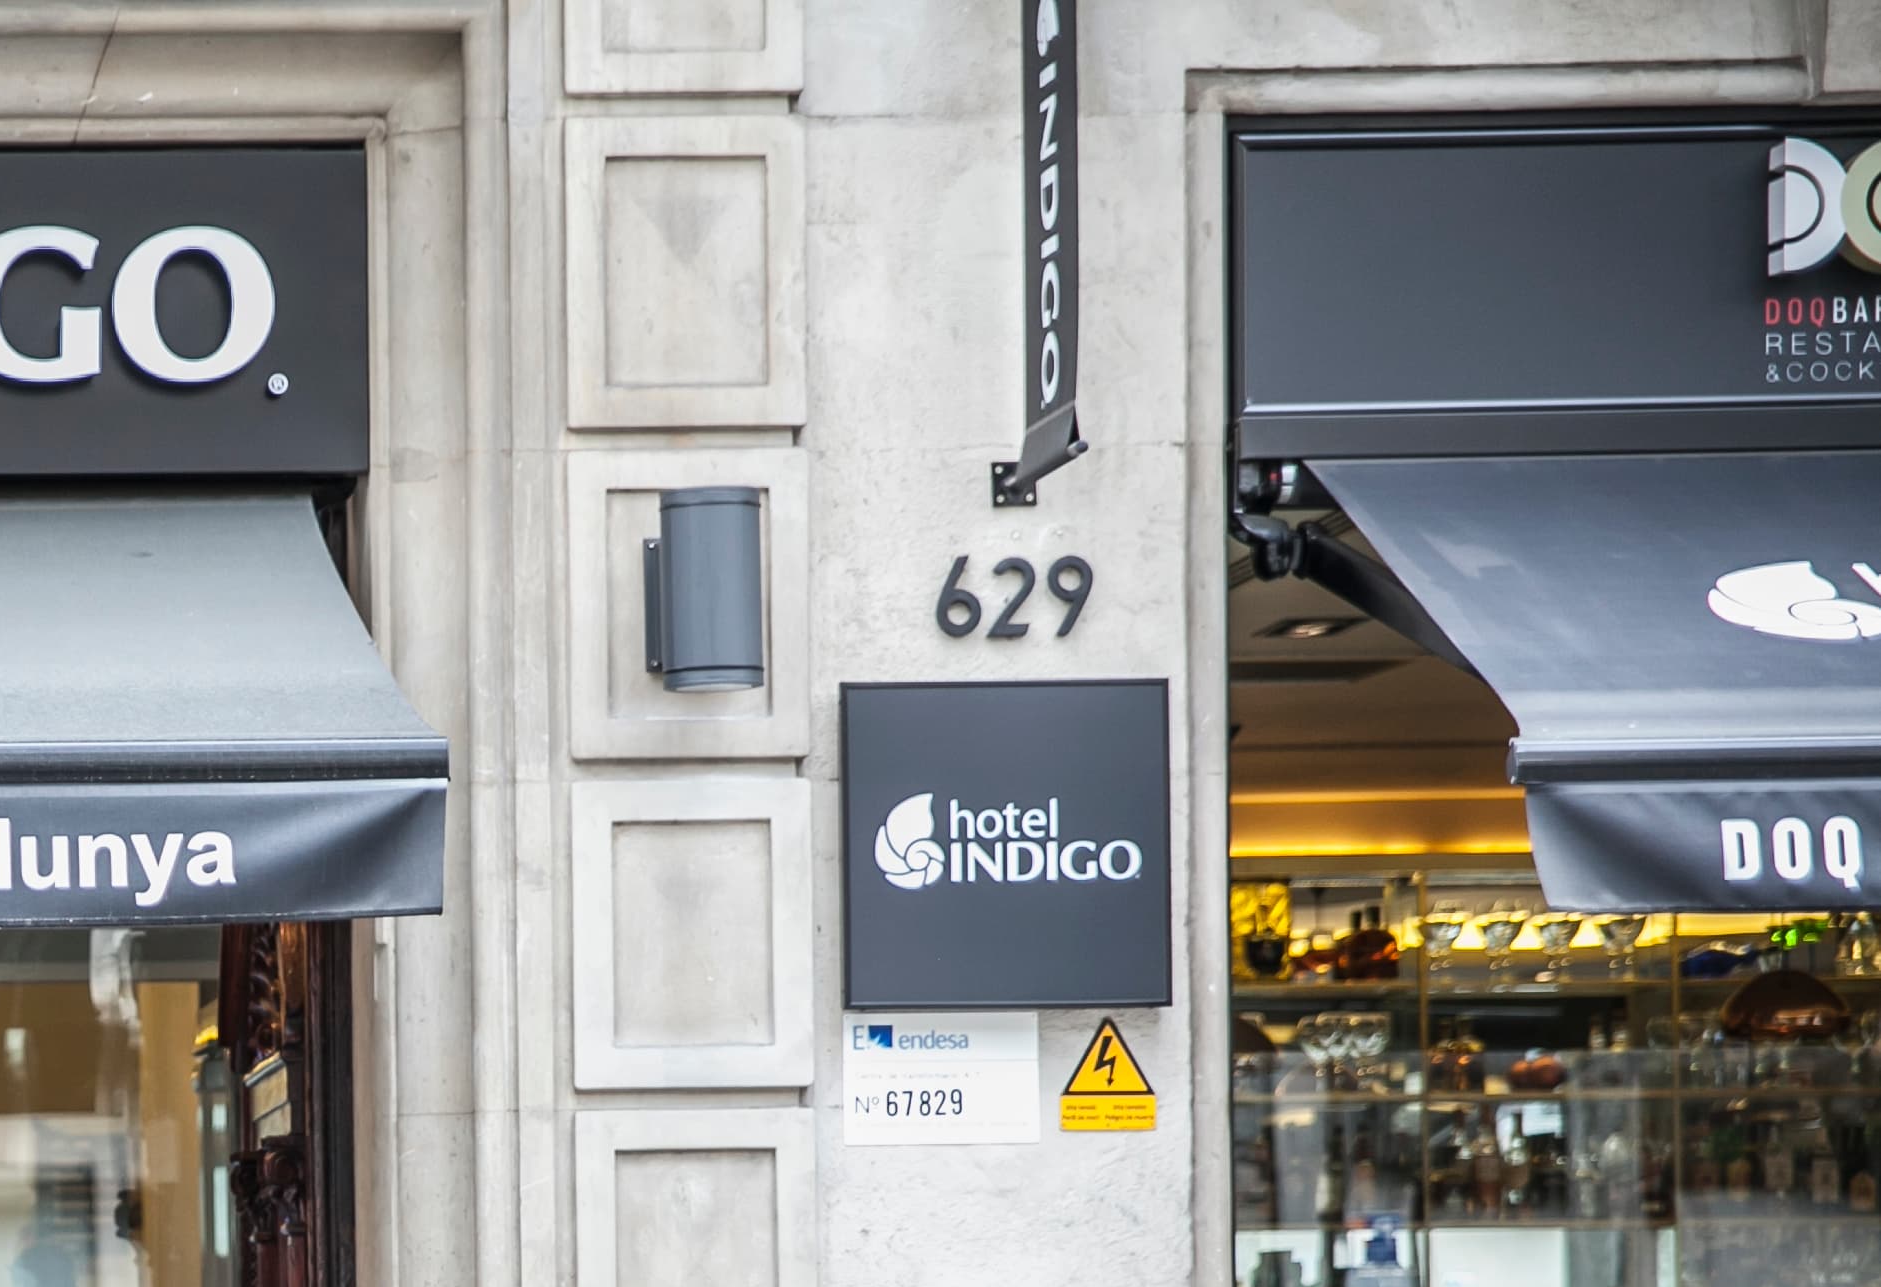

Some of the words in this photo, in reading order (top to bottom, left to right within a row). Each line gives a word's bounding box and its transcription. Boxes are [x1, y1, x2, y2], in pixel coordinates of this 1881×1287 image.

[1038, 60, 1061, 406] INDIGO
[935, 555, 1093, 641] 629
[949, 797, 1059, 839] hotel
[949, 839, 1143, 882] INDIGO
[1721, 815, 1862, 891] DOQ
[898, 1029, 969, 1050] endesa
[886, 1088, 964, 1117] 67829
